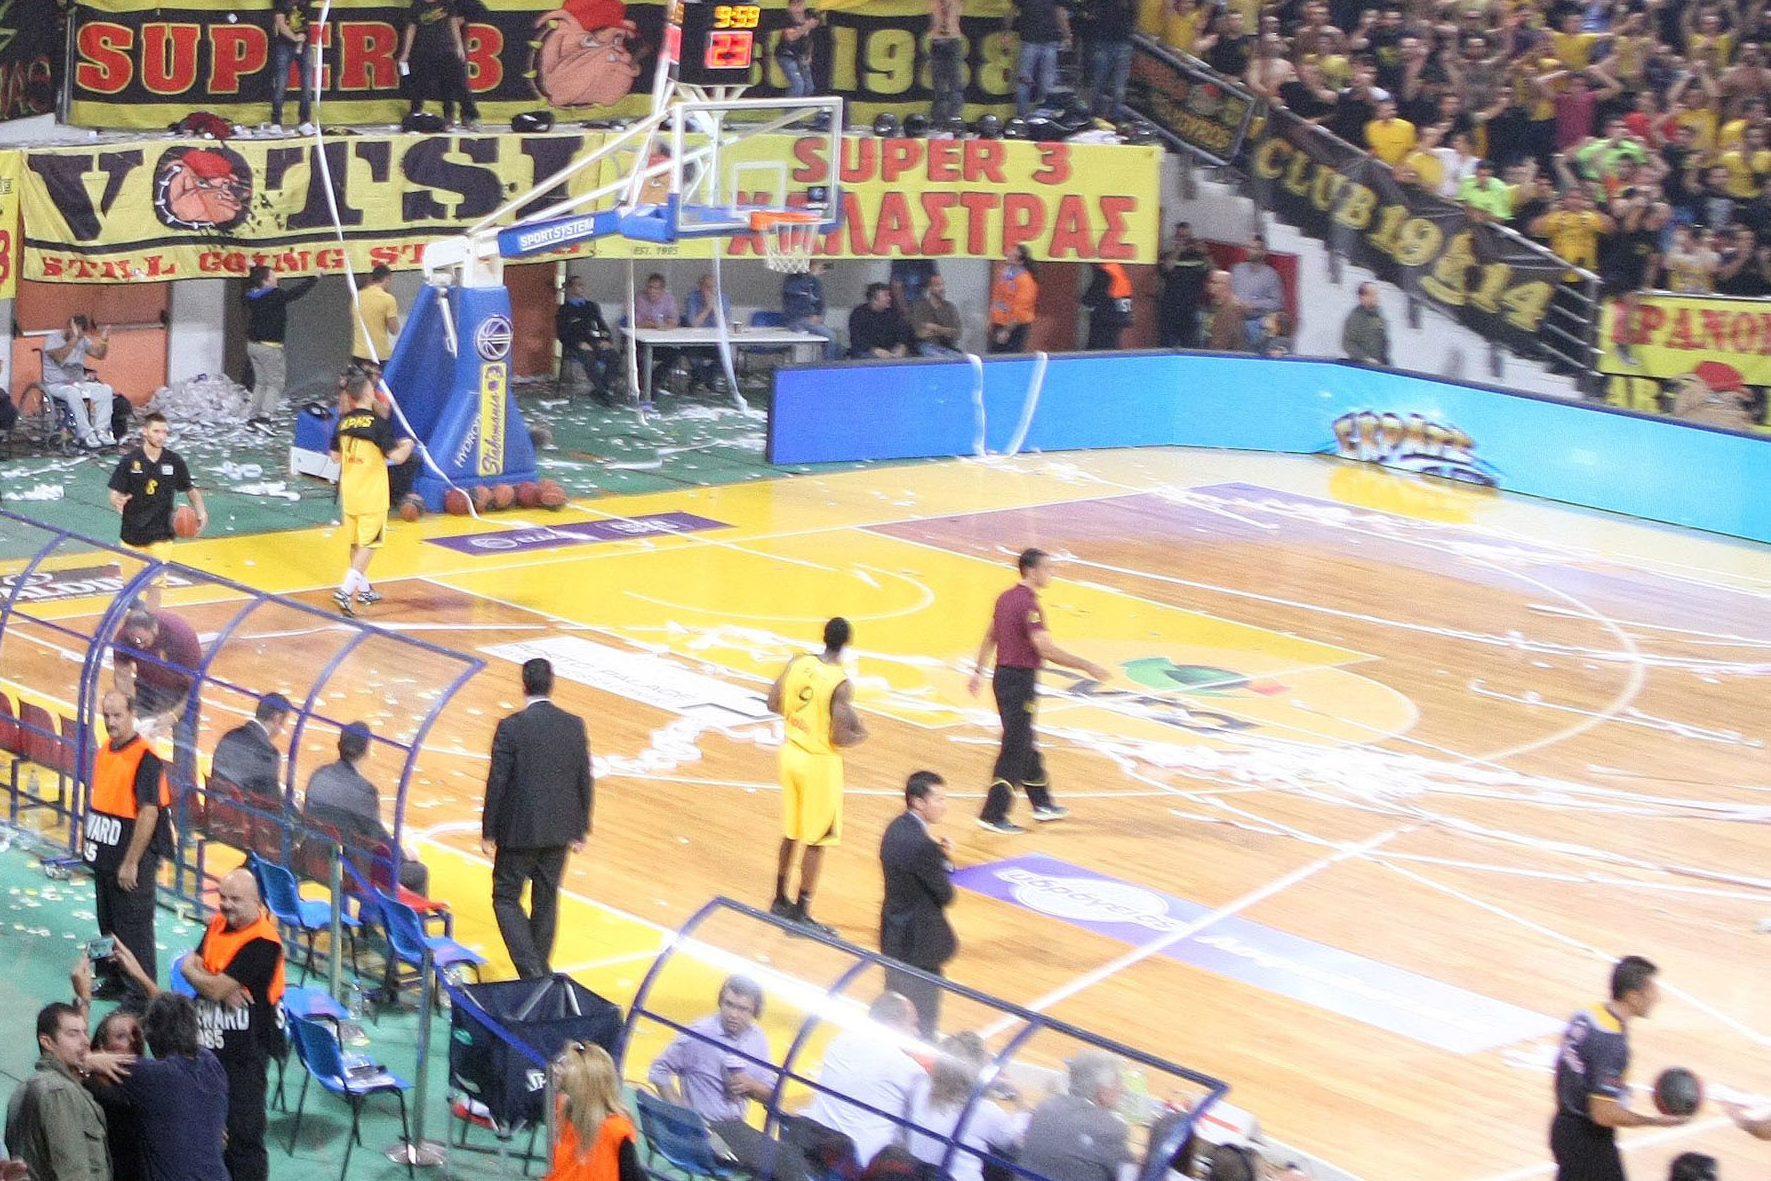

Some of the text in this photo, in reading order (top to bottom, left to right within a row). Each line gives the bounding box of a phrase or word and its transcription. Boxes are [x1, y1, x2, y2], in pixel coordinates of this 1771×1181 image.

[792, 136, 1073, 184] SUPER 3
[1254, 136, 1377, 232] CLUB
